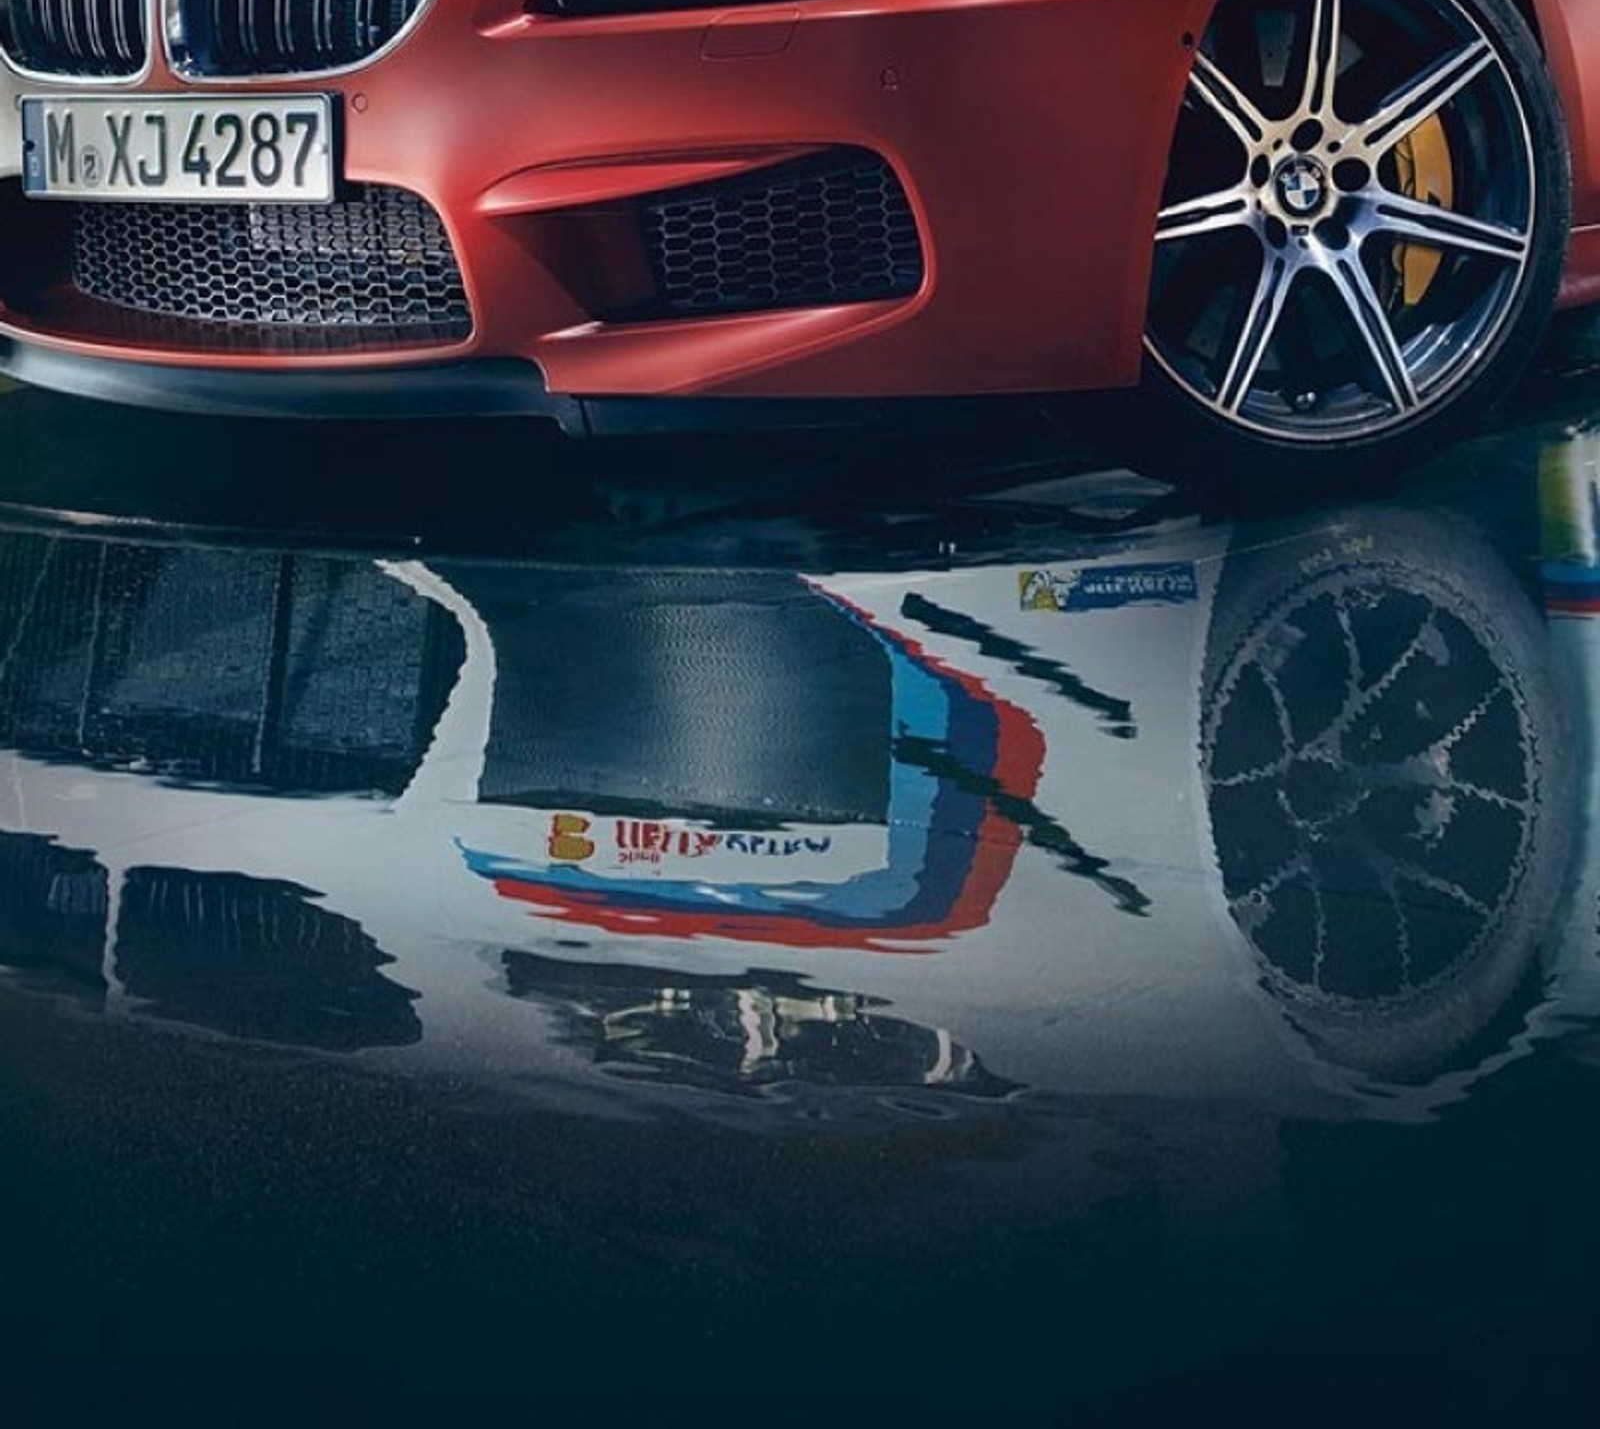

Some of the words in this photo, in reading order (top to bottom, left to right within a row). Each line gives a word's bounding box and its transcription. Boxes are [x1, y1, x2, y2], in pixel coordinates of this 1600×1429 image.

[47, 109, 76, 184] M
[105, 111, 168, 187] XJ
[181, 111, 319, 188] 4287
